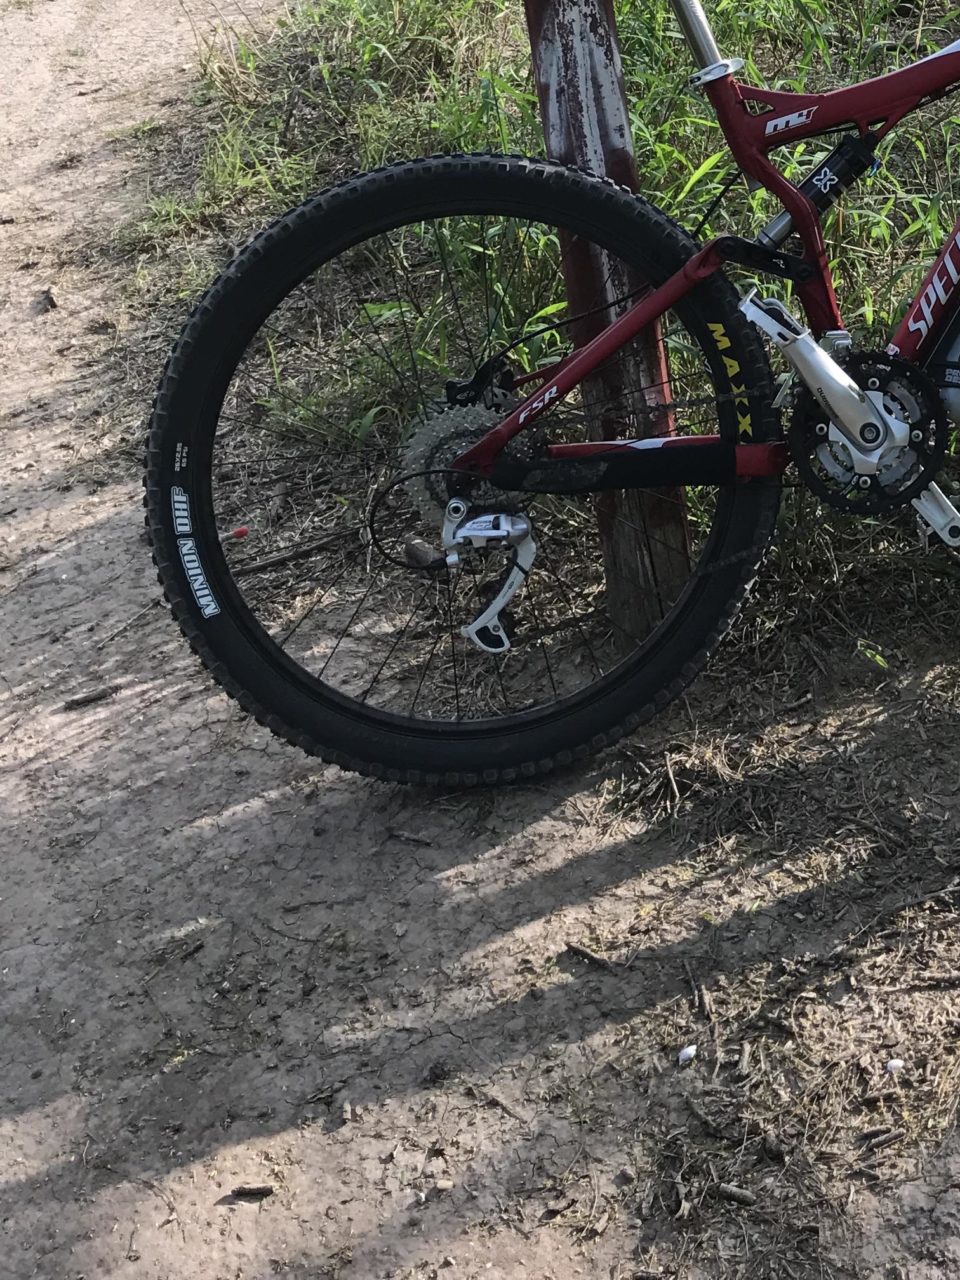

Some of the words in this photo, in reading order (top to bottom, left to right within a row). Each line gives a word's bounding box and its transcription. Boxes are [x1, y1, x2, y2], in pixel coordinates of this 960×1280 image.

[518, 385, 559, 424] FSR
[706, 323, 753, 438] MAXX
[171, 486, 192, 535] DHF
[177, 538, 221, 618] MINION
